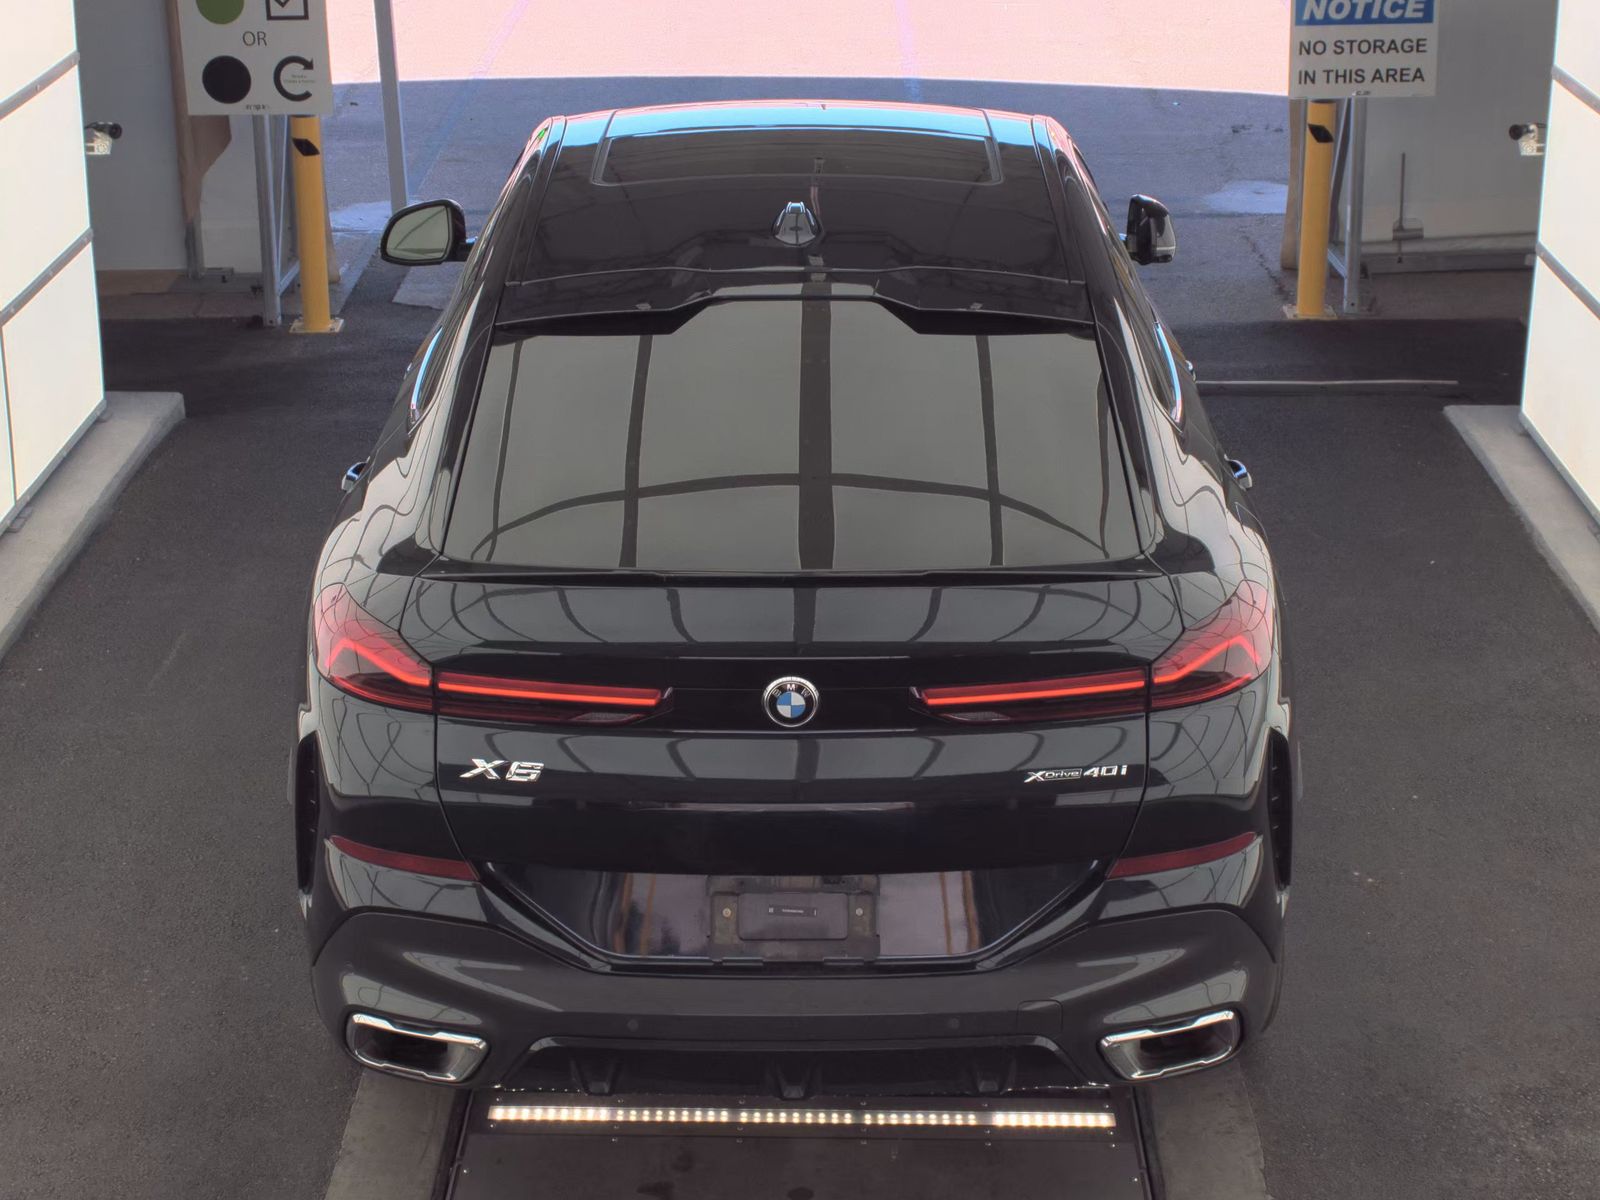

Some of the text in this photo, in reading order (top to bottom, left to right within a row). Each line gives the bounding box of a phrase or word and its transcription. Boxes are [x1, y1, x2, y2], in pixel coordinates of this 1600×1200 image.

[1302, 0, 1425, 20] NOTICE
[242, 31, 268, 46] OR
[1299, 38, 1428, 56] NO STORAGE
[1299, 68, 1425, 85] IN THIS AREA
[772, 683, 811, 697] BMW
[459, 758, 545, 782] X6
